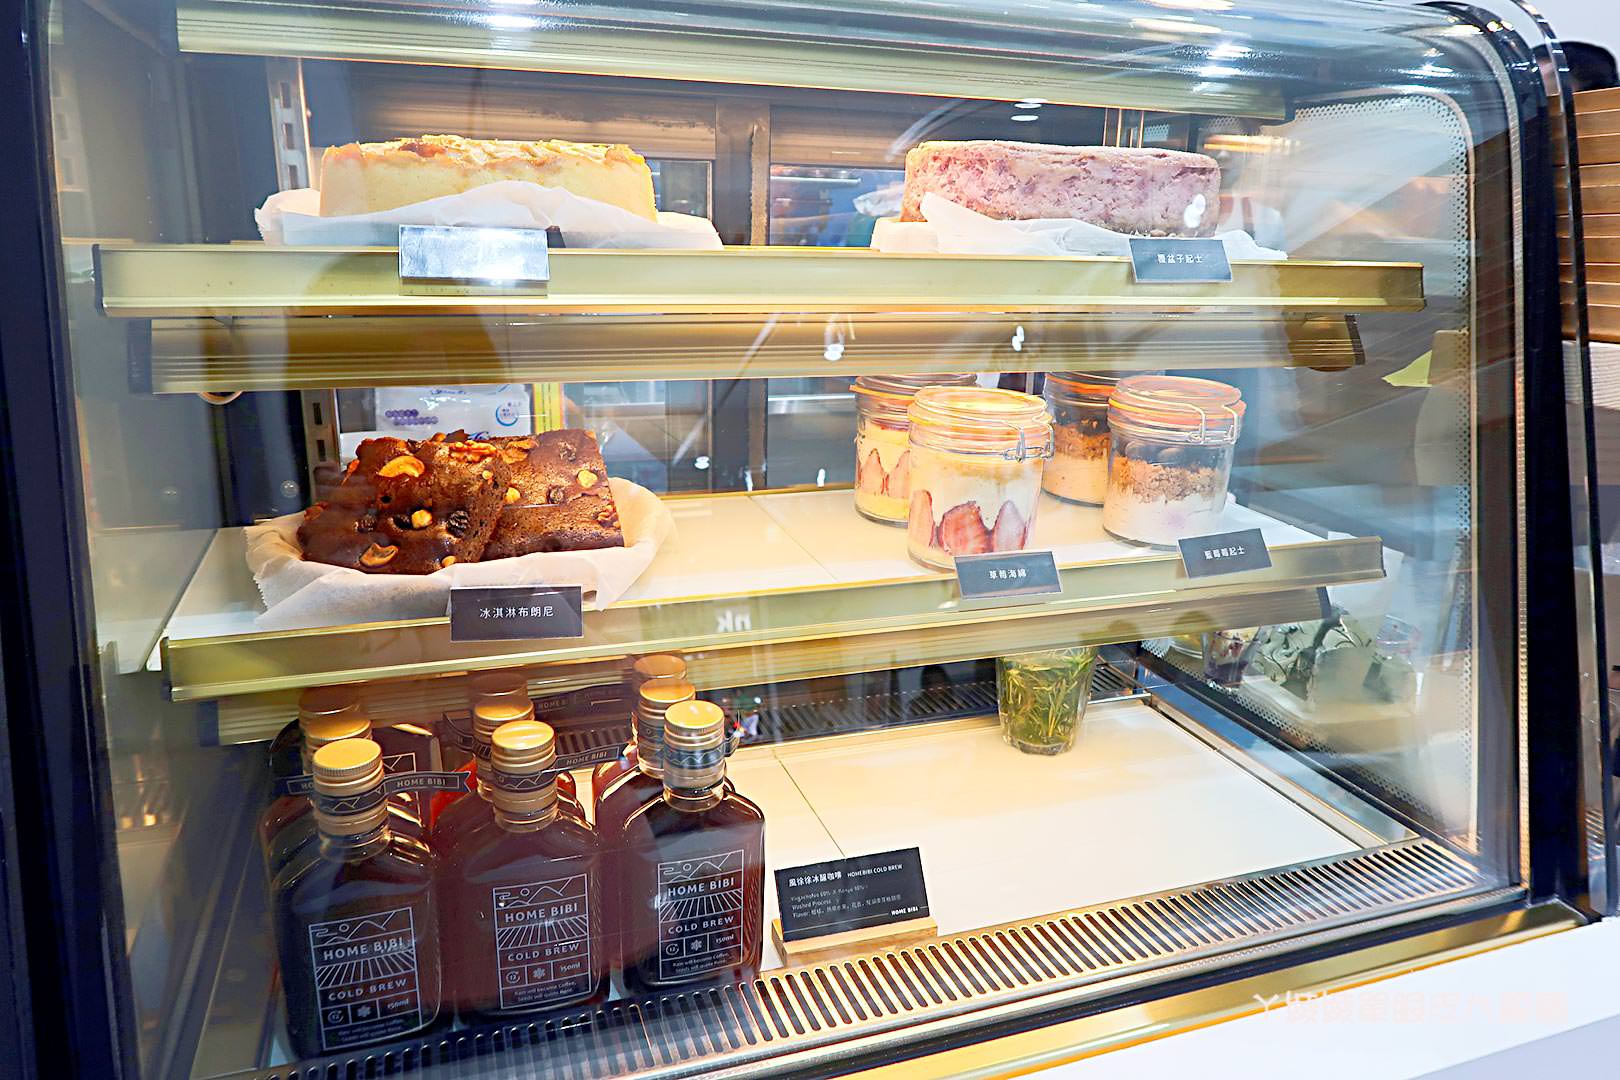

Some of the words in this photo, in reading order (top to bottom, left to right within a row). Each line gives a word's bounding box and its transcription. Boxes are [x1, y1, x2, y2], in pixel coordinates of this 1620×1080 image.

[479, 605, 554, 619] 冰淇淋布朗尼
[566, 755, 589, 766] HOME
[590, 752, 608, 763] BIBI
[396, 777, 424, 788] HOME
[427, 776, 446, 786] BIBI
[873, 865, 888, 874] COLD
[888, 863, 903, 872] BREW
[668, 882, 705, 897] HOME
[709, 877, 735, 890] BIBI
[505, 908, 546, 923] HOME
[550, 902, 578, 917] BIBI
[890, 908, 907, 916] HOME
[668, 923, 698, 935] COLD
[702, 916, 735, 929] BREW
[323, 943, 369, 961] HOME
[373, 936, 403, 952] BIBI
[507, 950, 540, 962] COLD
[545, 943, 580, 957] BREW
[328, 987, 364, 1001] COLD
[369, 978, 407, 994] BREW
